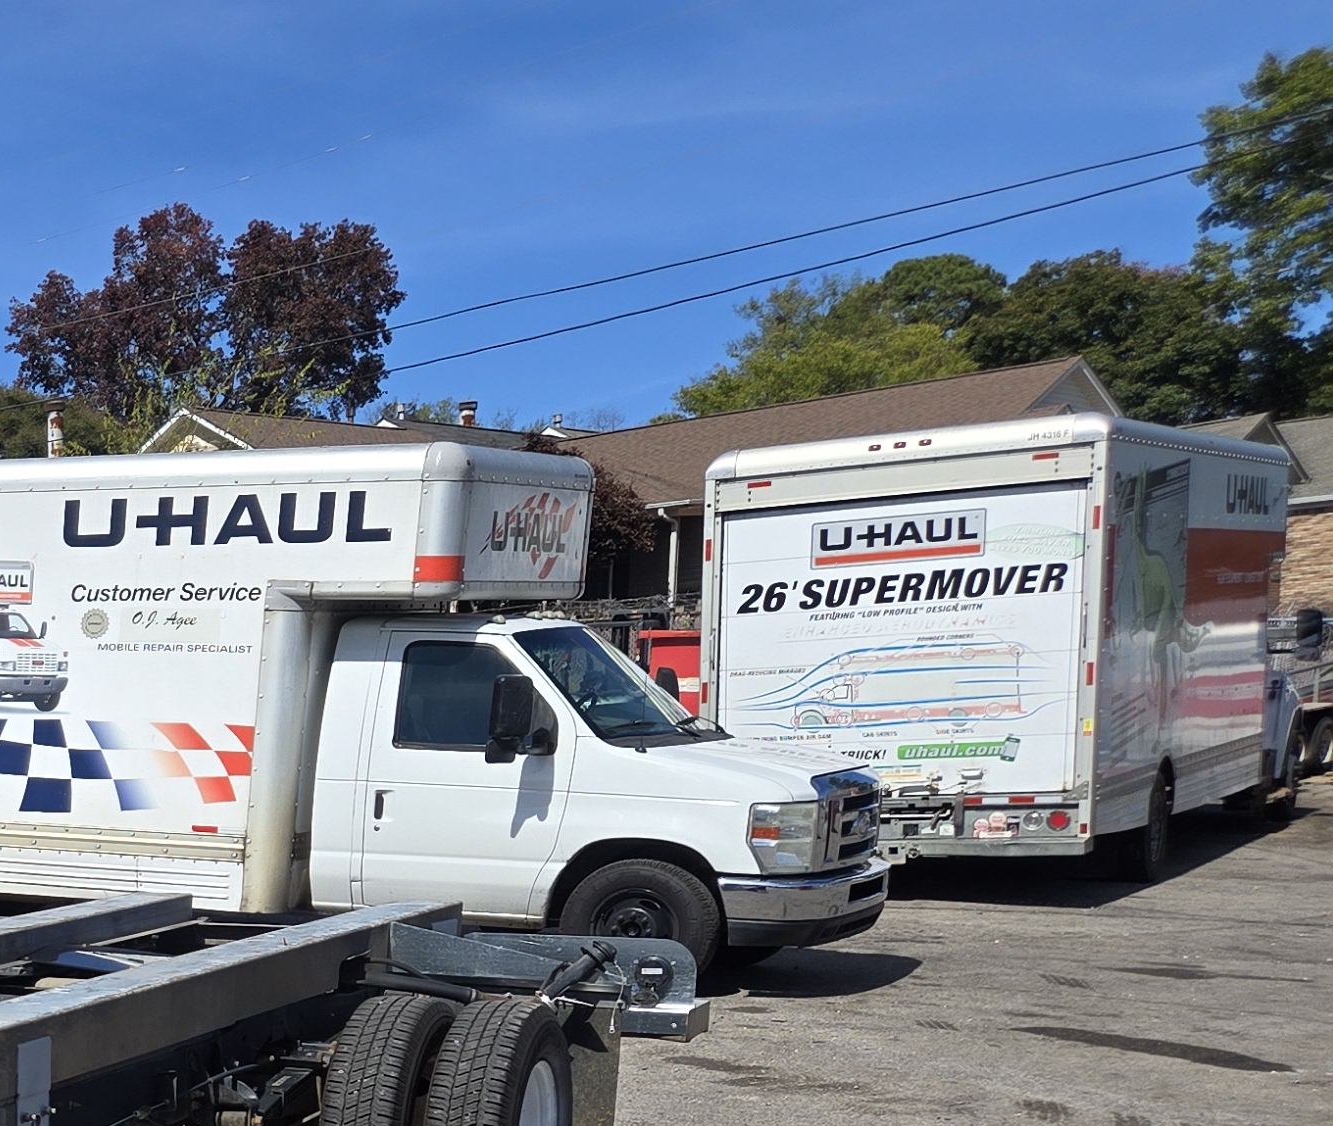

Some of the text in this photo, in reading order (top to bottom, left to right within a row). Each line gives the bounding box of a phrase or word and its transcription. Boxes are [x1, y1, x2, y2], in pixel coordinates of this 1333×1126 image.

[1226, 473, 1269, 515] U-HAUL
[62, 491, 392, 548] U-HAUL
[490, 510, 566, 554] U-HAUL
[819, 516, 979, 551] U-HAUL
[71, 582, 262, 603] Customer Service
[737, 562, 1069, 615] 26' SUPERMOVER
[808, 612, 856, 622] FEATURING
[959, 603, 983, 612] WITH
[97, 643, 254, 654] MOBILE REPAIR SPECIALIST
[904, 742, 1006, 759] uhaul.com
